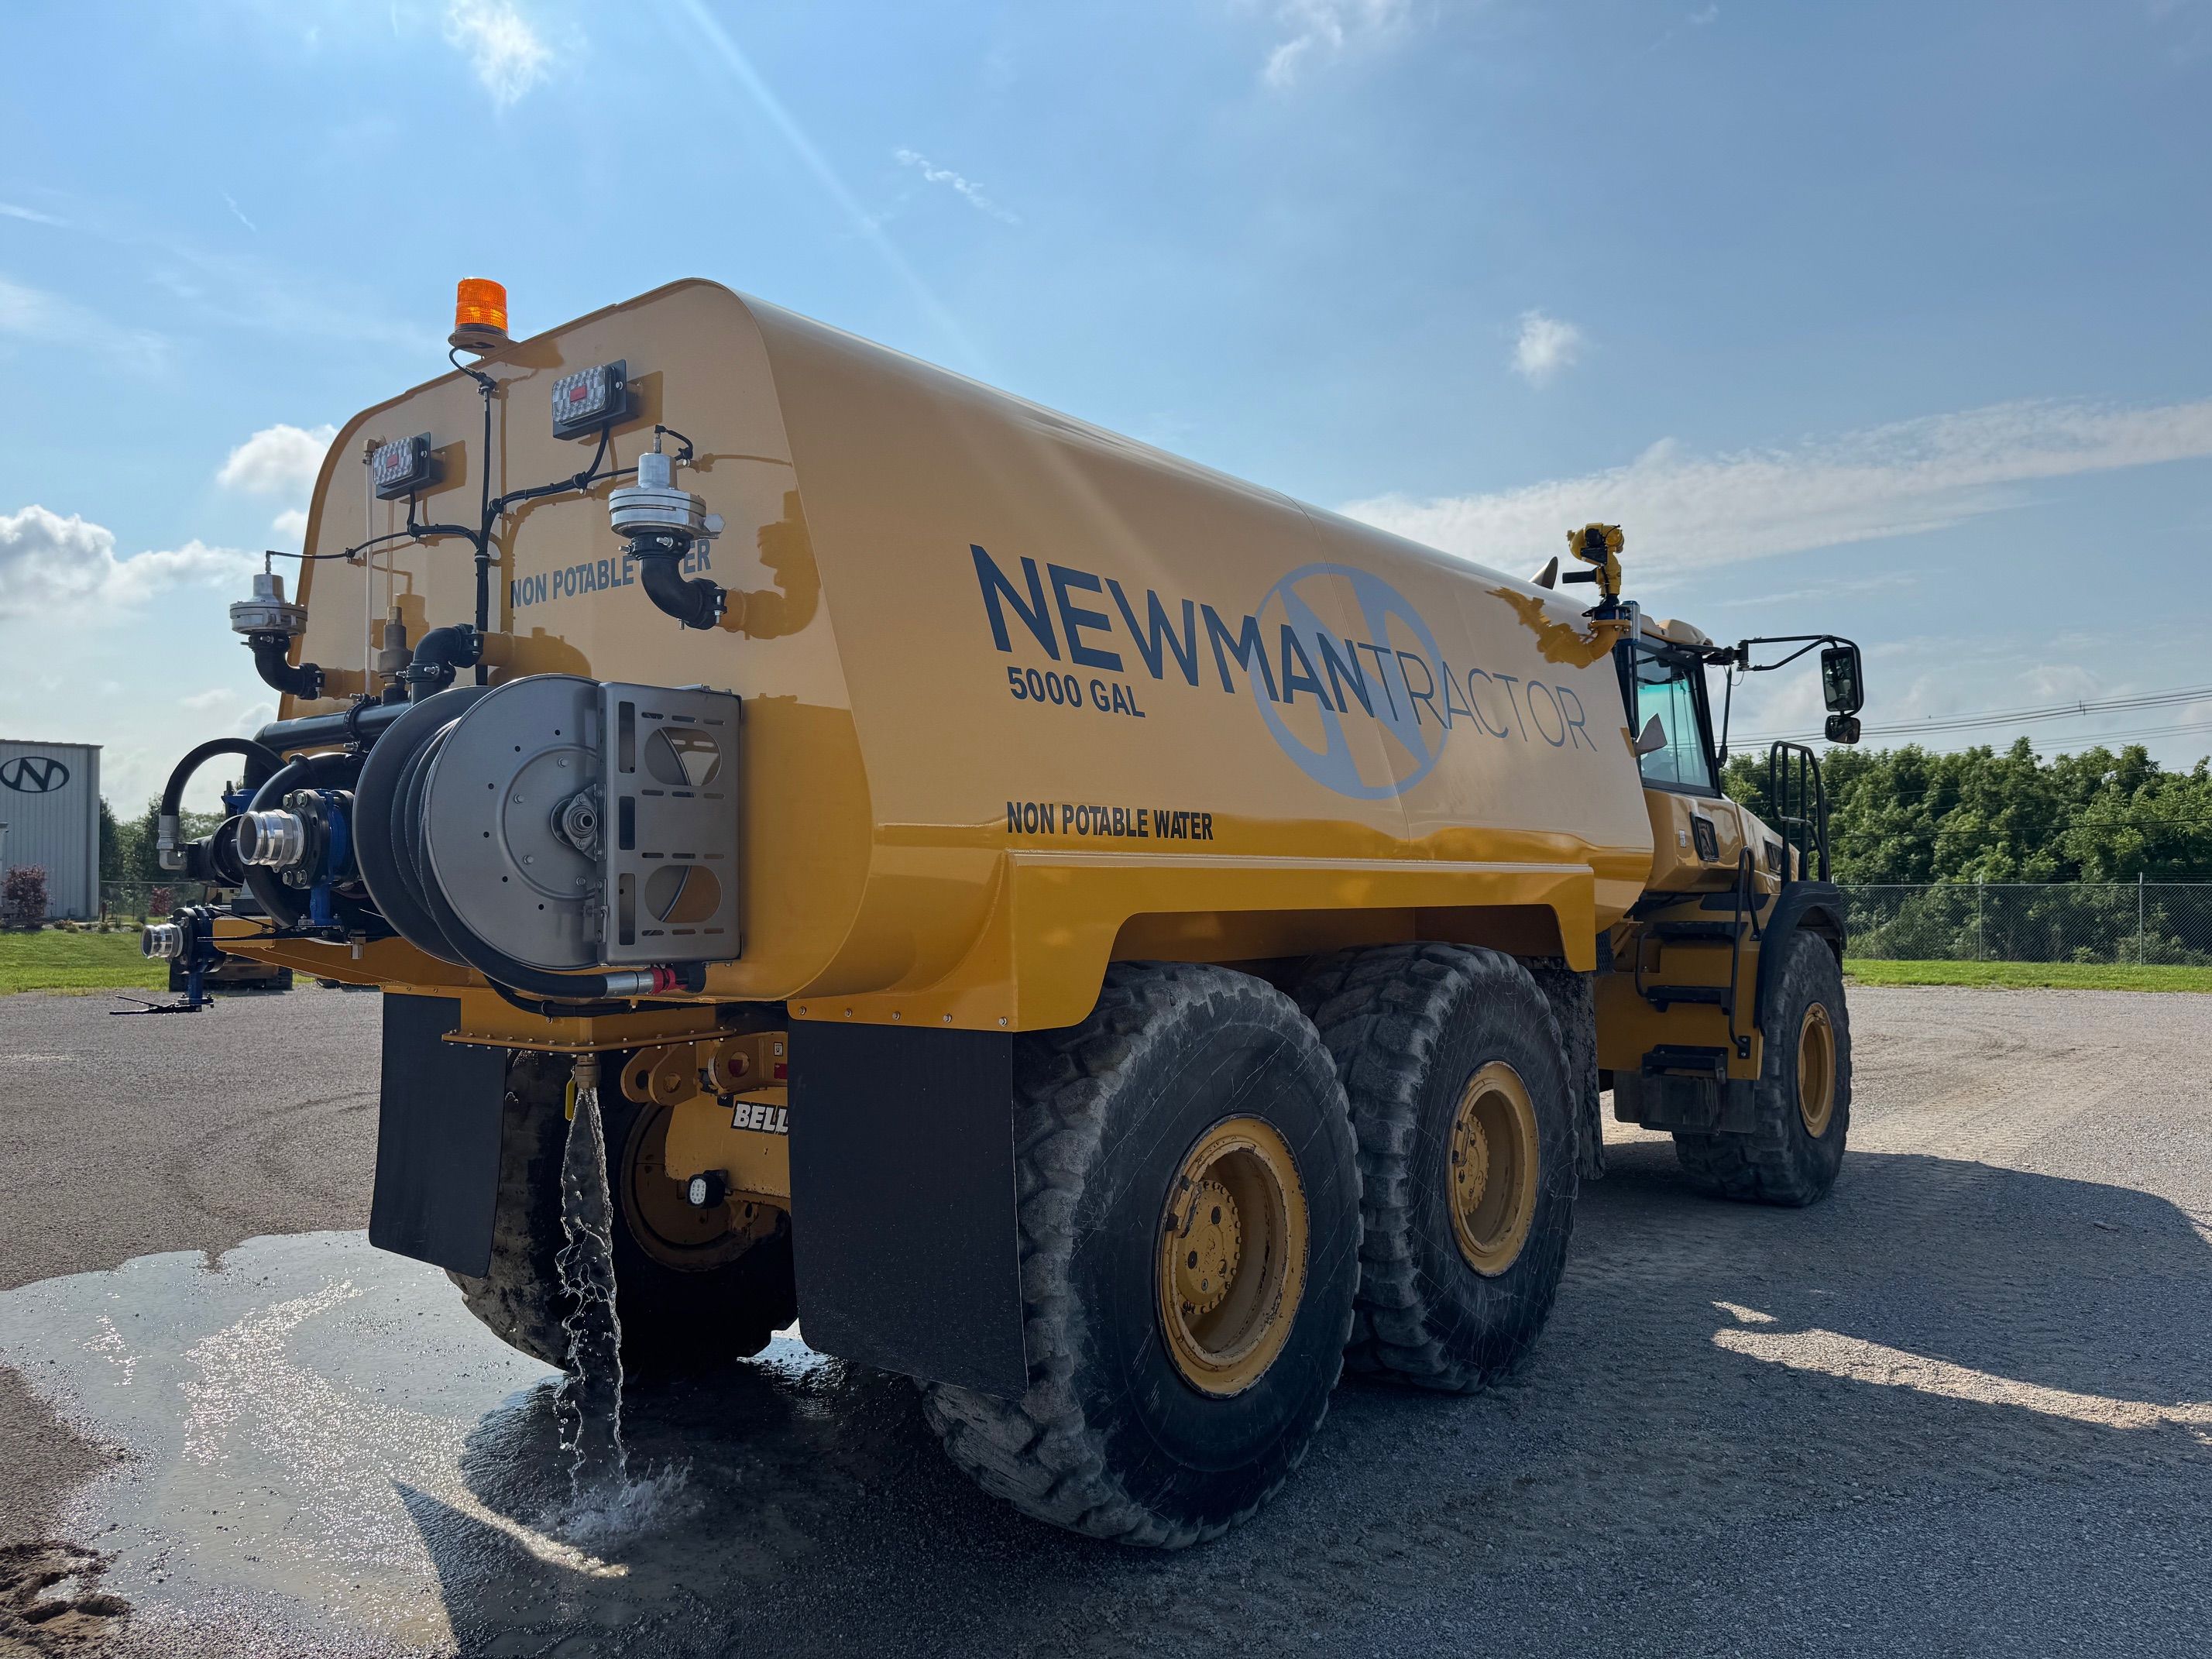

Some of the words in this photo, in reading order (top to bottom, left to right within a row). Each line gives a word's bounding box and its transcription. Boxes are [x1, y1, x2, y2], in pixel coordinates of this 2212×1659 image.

[511, 572, 546, 608] NON
[553, 555, 634, 600] POTABLE
[1007, 666, 1083, 708] 5000
[1090, 678, 1146, 718] GAL
[1007, 801, 1055, 835] NON
[1062, 804, 1149, 838] POTABLE
[1153, 809, 1214, 840] WATER
[733, 1102, 788, 1133] BELL
